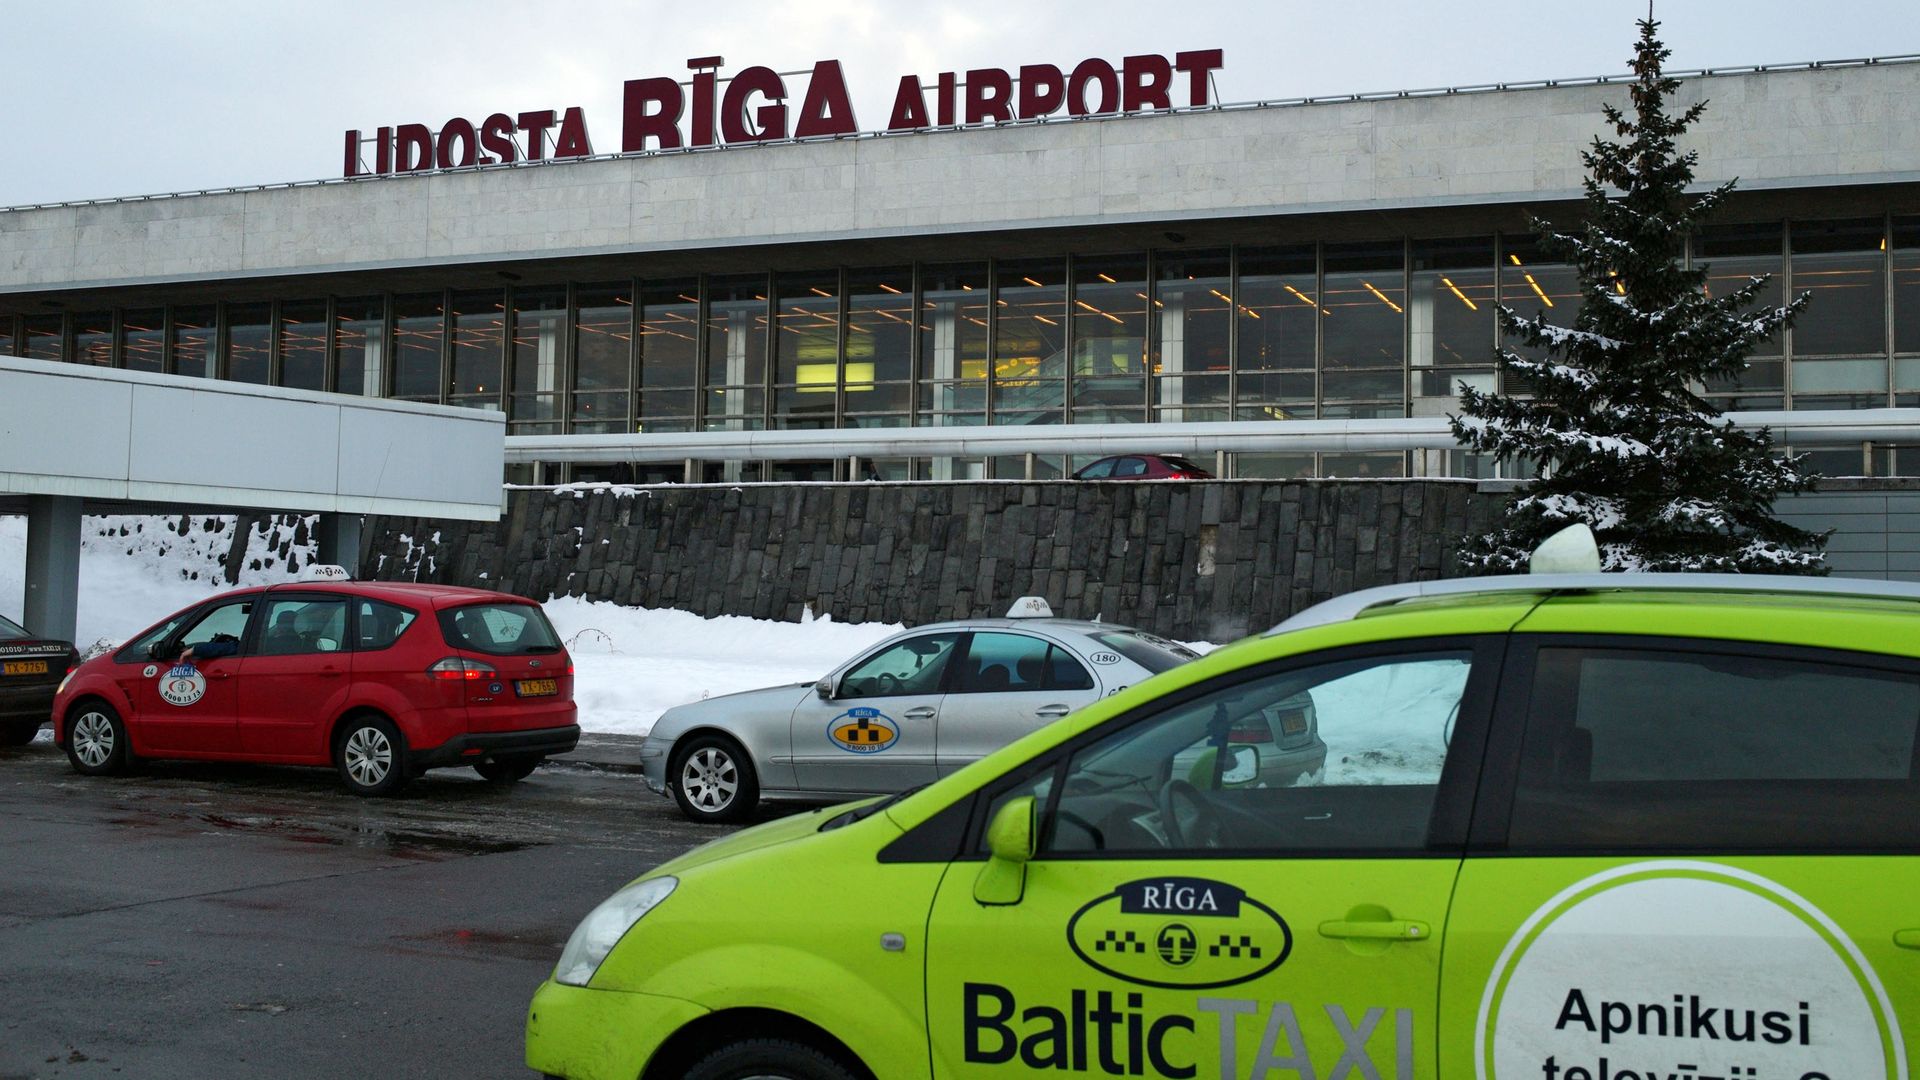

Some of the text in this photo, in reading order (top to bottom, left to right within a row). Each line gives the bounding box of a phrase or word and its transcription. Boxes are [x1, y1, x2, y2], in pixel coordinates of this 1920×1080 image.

[344, 48, 1224, 178] LIDOSTA RĪGA AIRPORT
[1096, 654, 1116, 662] 180
[1143, 883, 1219, 911] RĪGA
[1555, 988, 1811, 1046] Apnikusi
